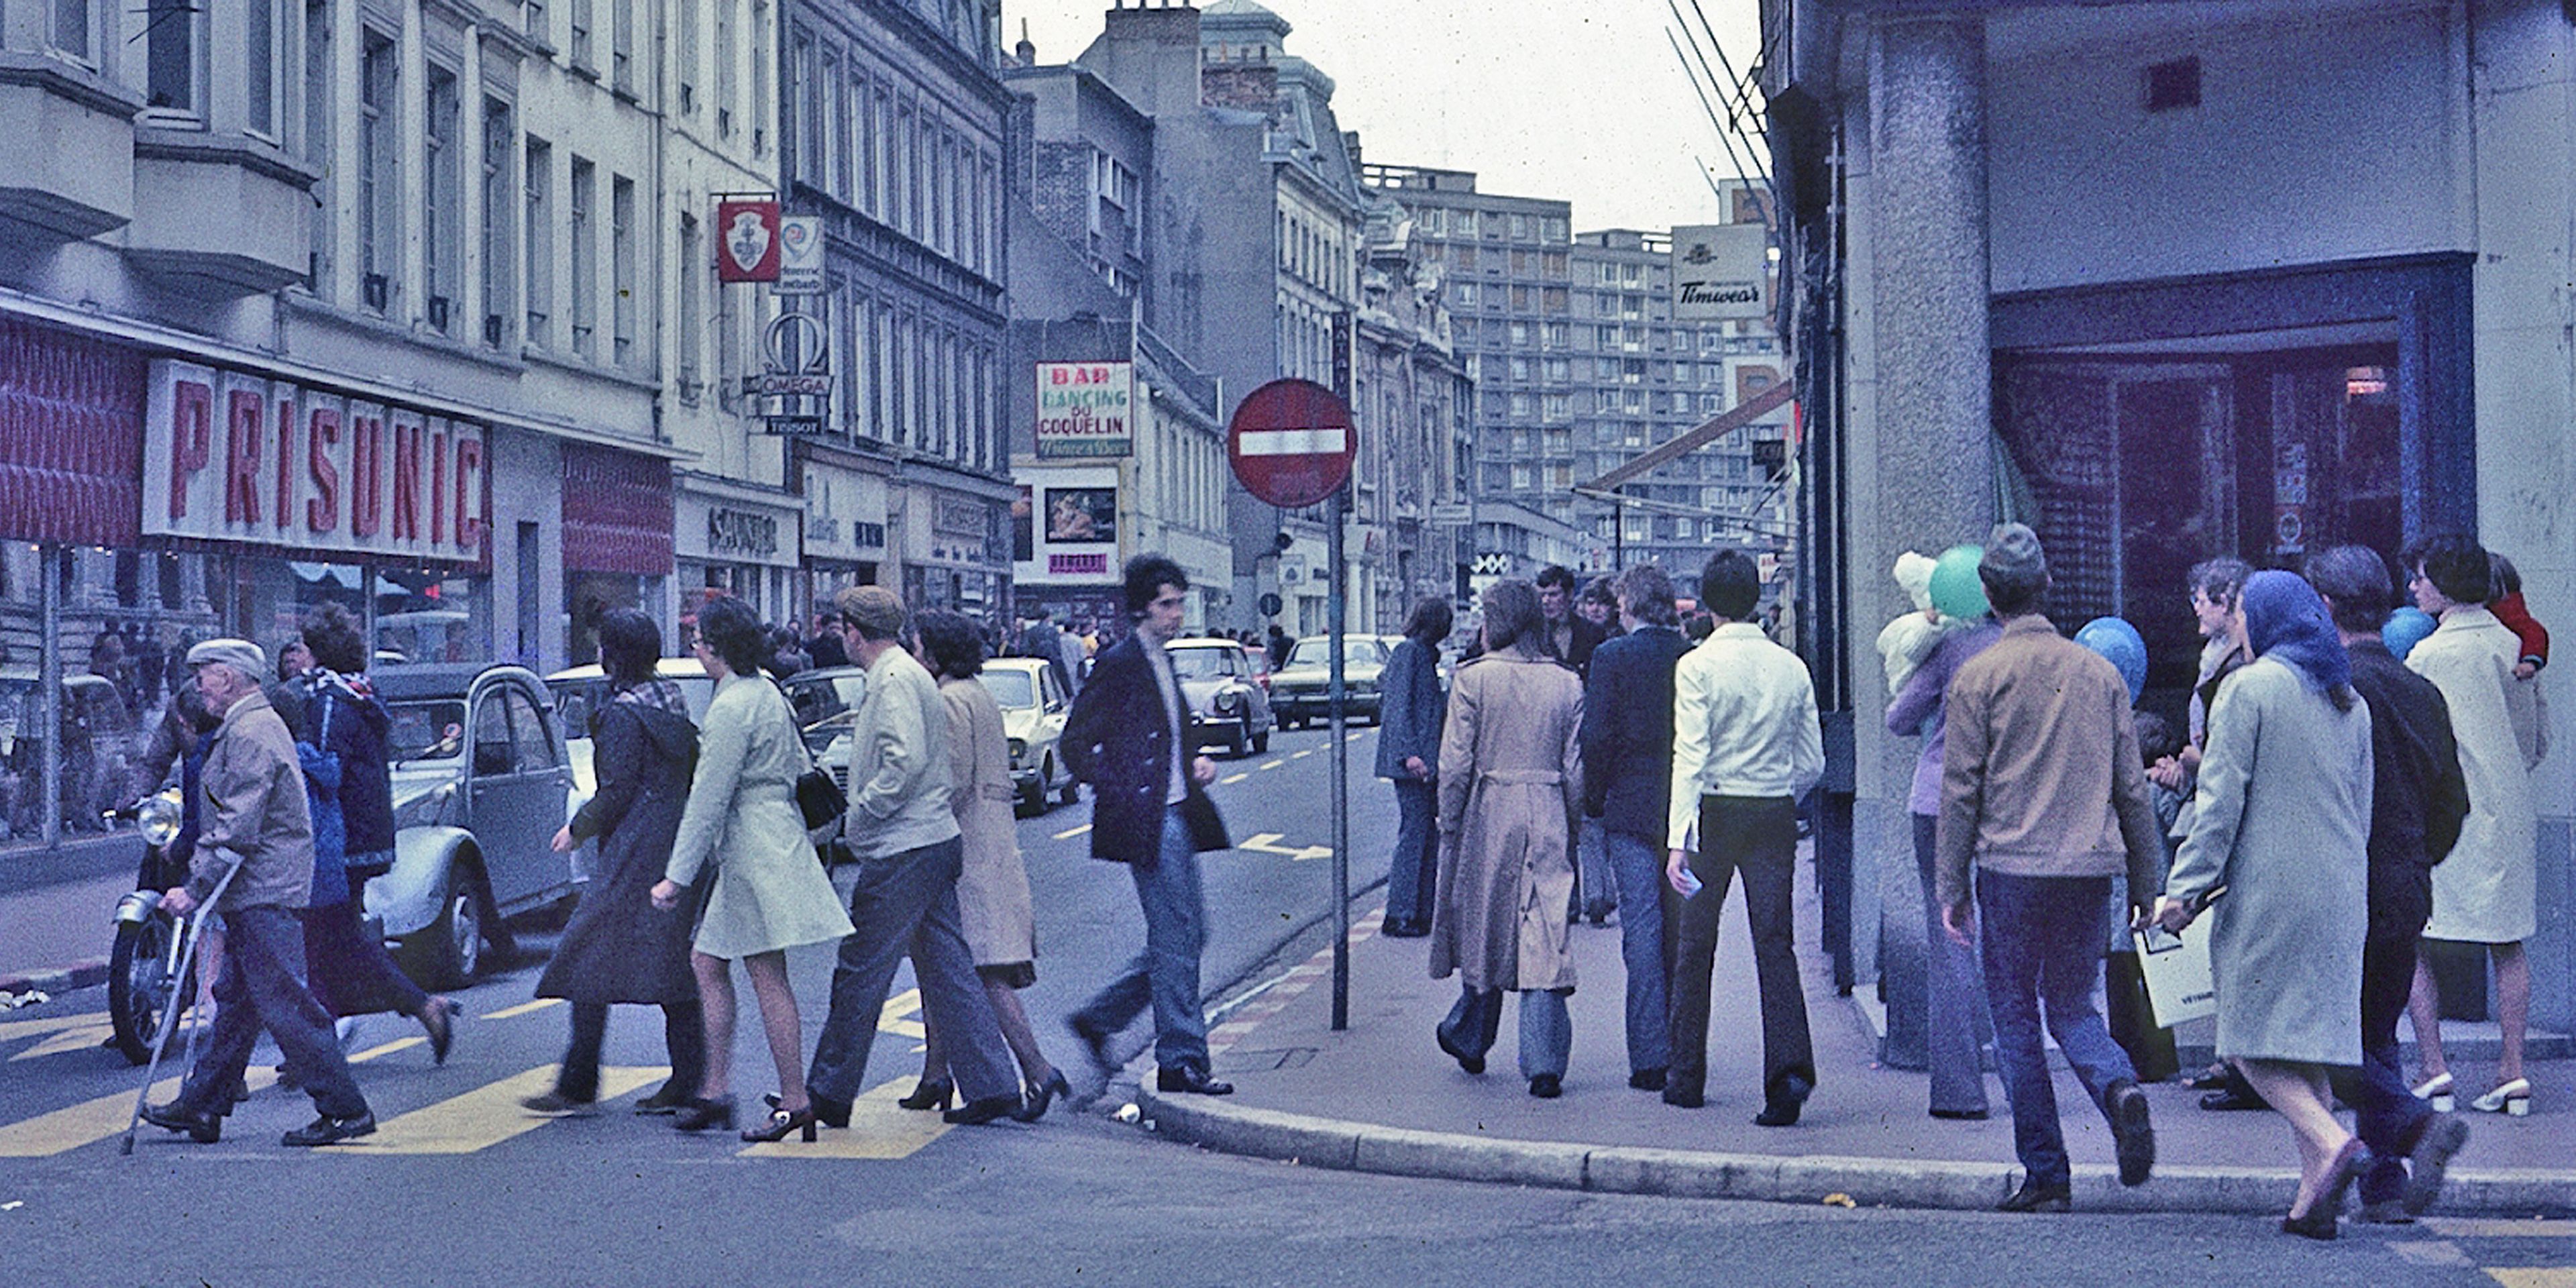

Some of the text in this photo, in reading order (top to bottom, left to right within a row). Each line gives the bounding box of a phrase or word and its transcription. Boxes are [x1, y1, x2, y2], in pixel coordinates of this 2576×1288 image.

[1680, 281, 1759, 303] Timwear
[1052, 367, 1110, 385] BAR
[764, 378, 826, 394] OMEGA
[1042, 390, 1127, 409] DANCING
[1040, 417, 1124, 436] COQUELIN
[170, 380, 486, 549] PRISUNIC
